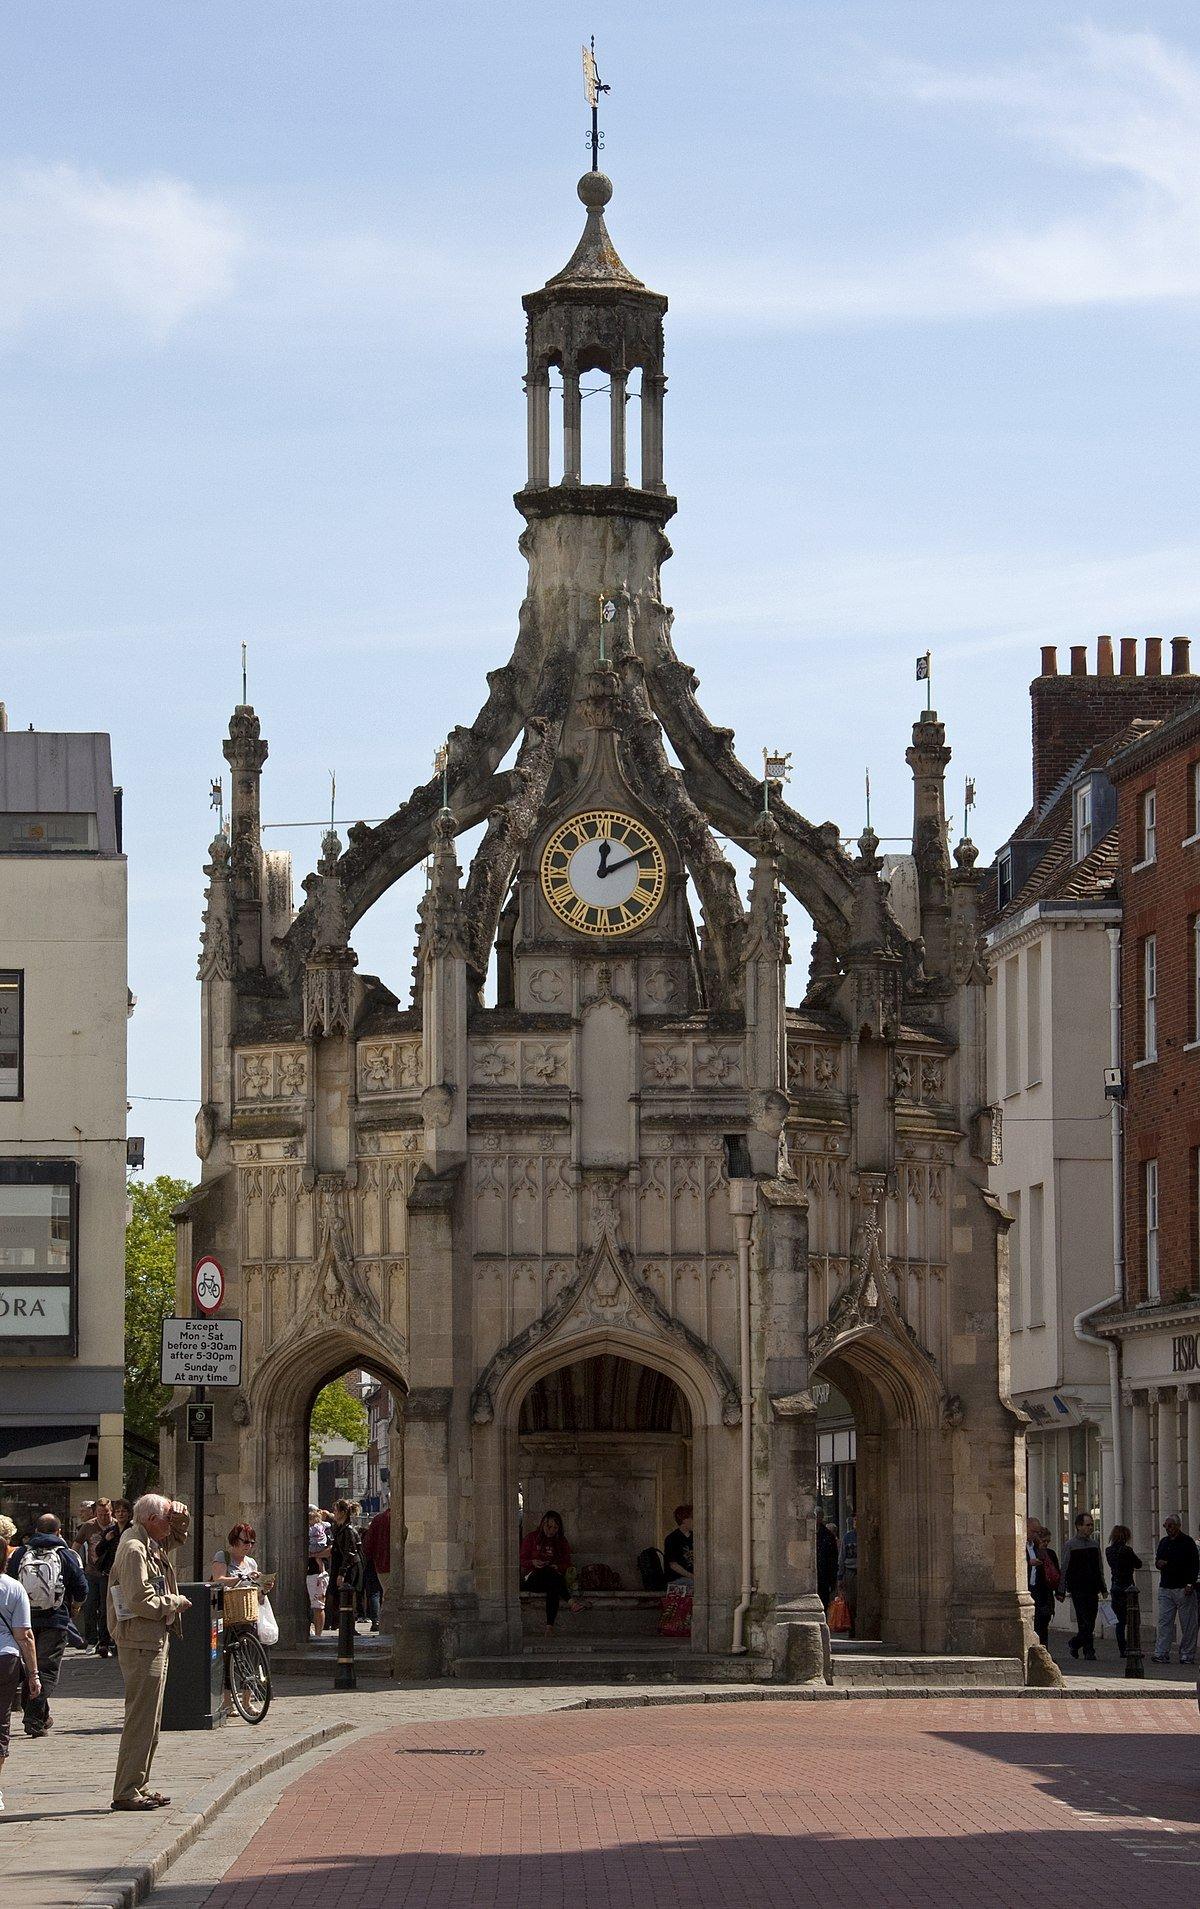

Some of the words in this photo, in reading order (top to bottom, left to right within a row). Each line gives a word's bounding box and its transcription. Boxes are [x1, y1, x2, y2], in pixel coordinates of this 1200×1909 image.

[185, 1322, 219, 1332] Except
[180, 1332, 200, 1340] Mon
[207, 1332, 224, 1341] Sat
[167, 1341, 198, 1350] before
[170, 1351, 194, 1360] after
[184, 1362, 219, 1373] Sunday
[174, 1372, 186, 1381] At
[188, 1374, 204, 1383] any
[206, 1373, 228, 1382] time
